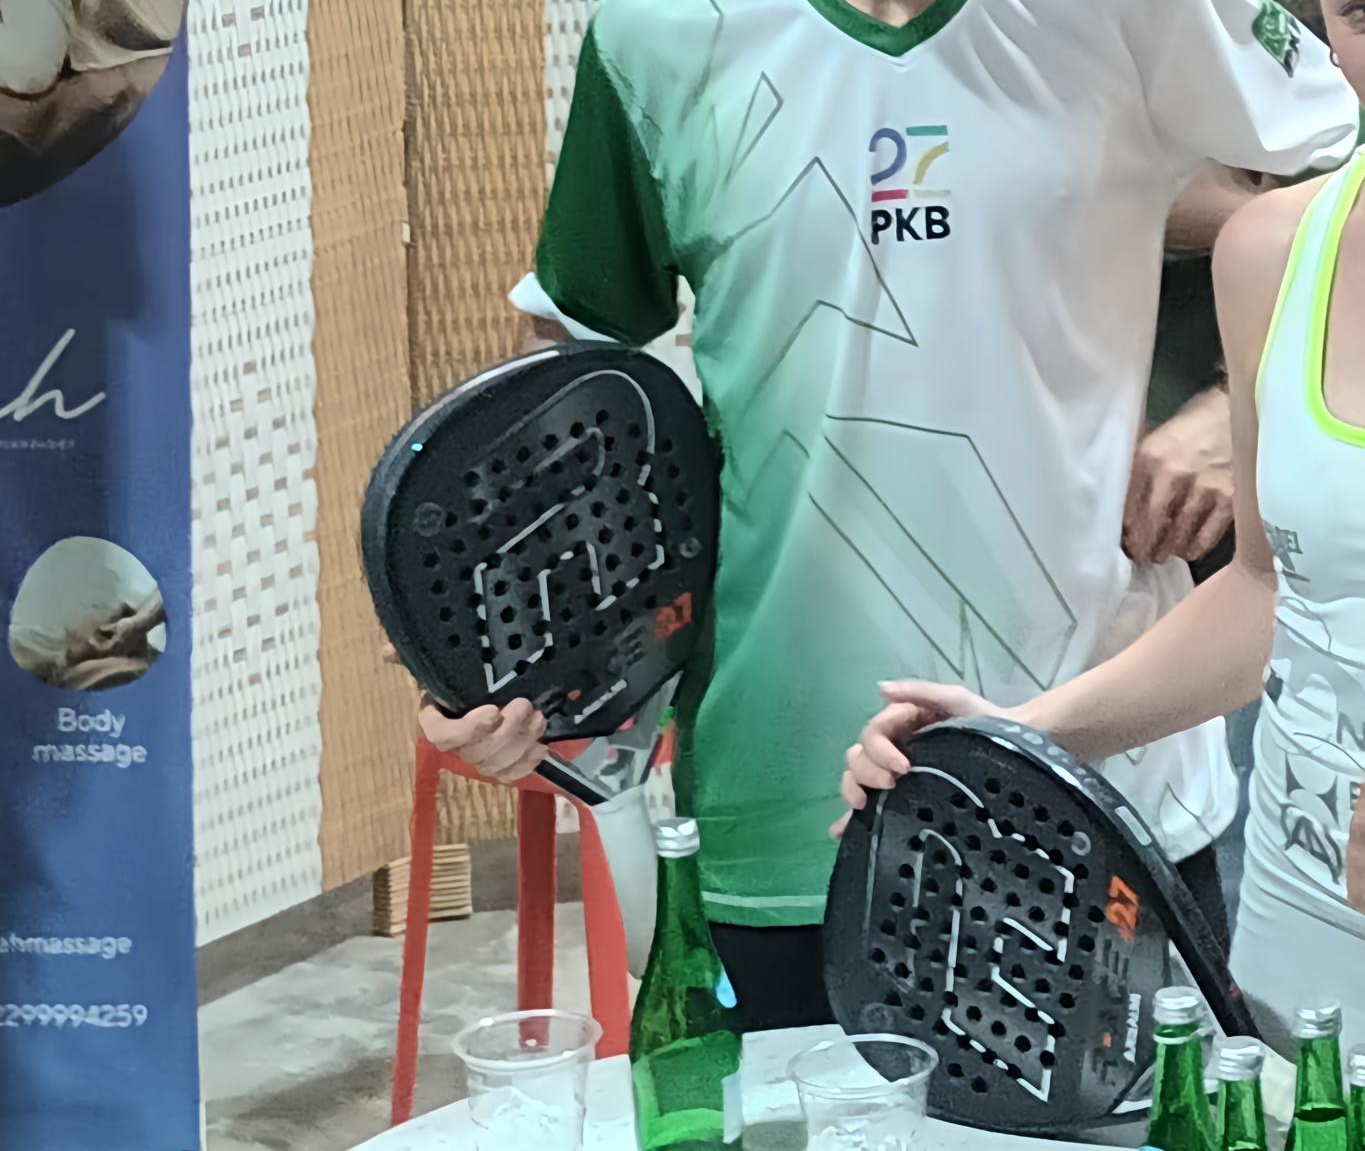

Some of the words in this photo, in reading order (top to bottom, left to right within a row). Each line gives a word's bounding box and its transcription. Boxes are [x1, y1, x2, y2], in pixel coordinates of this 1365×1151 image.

[869, 125, 951, 202] 27
[871, 206, 951, 245] PKB
[57, 707, 126, 738] Body
[32, 743, 148, 768] massage
[0, 1003, 148, 1027] 299994259
